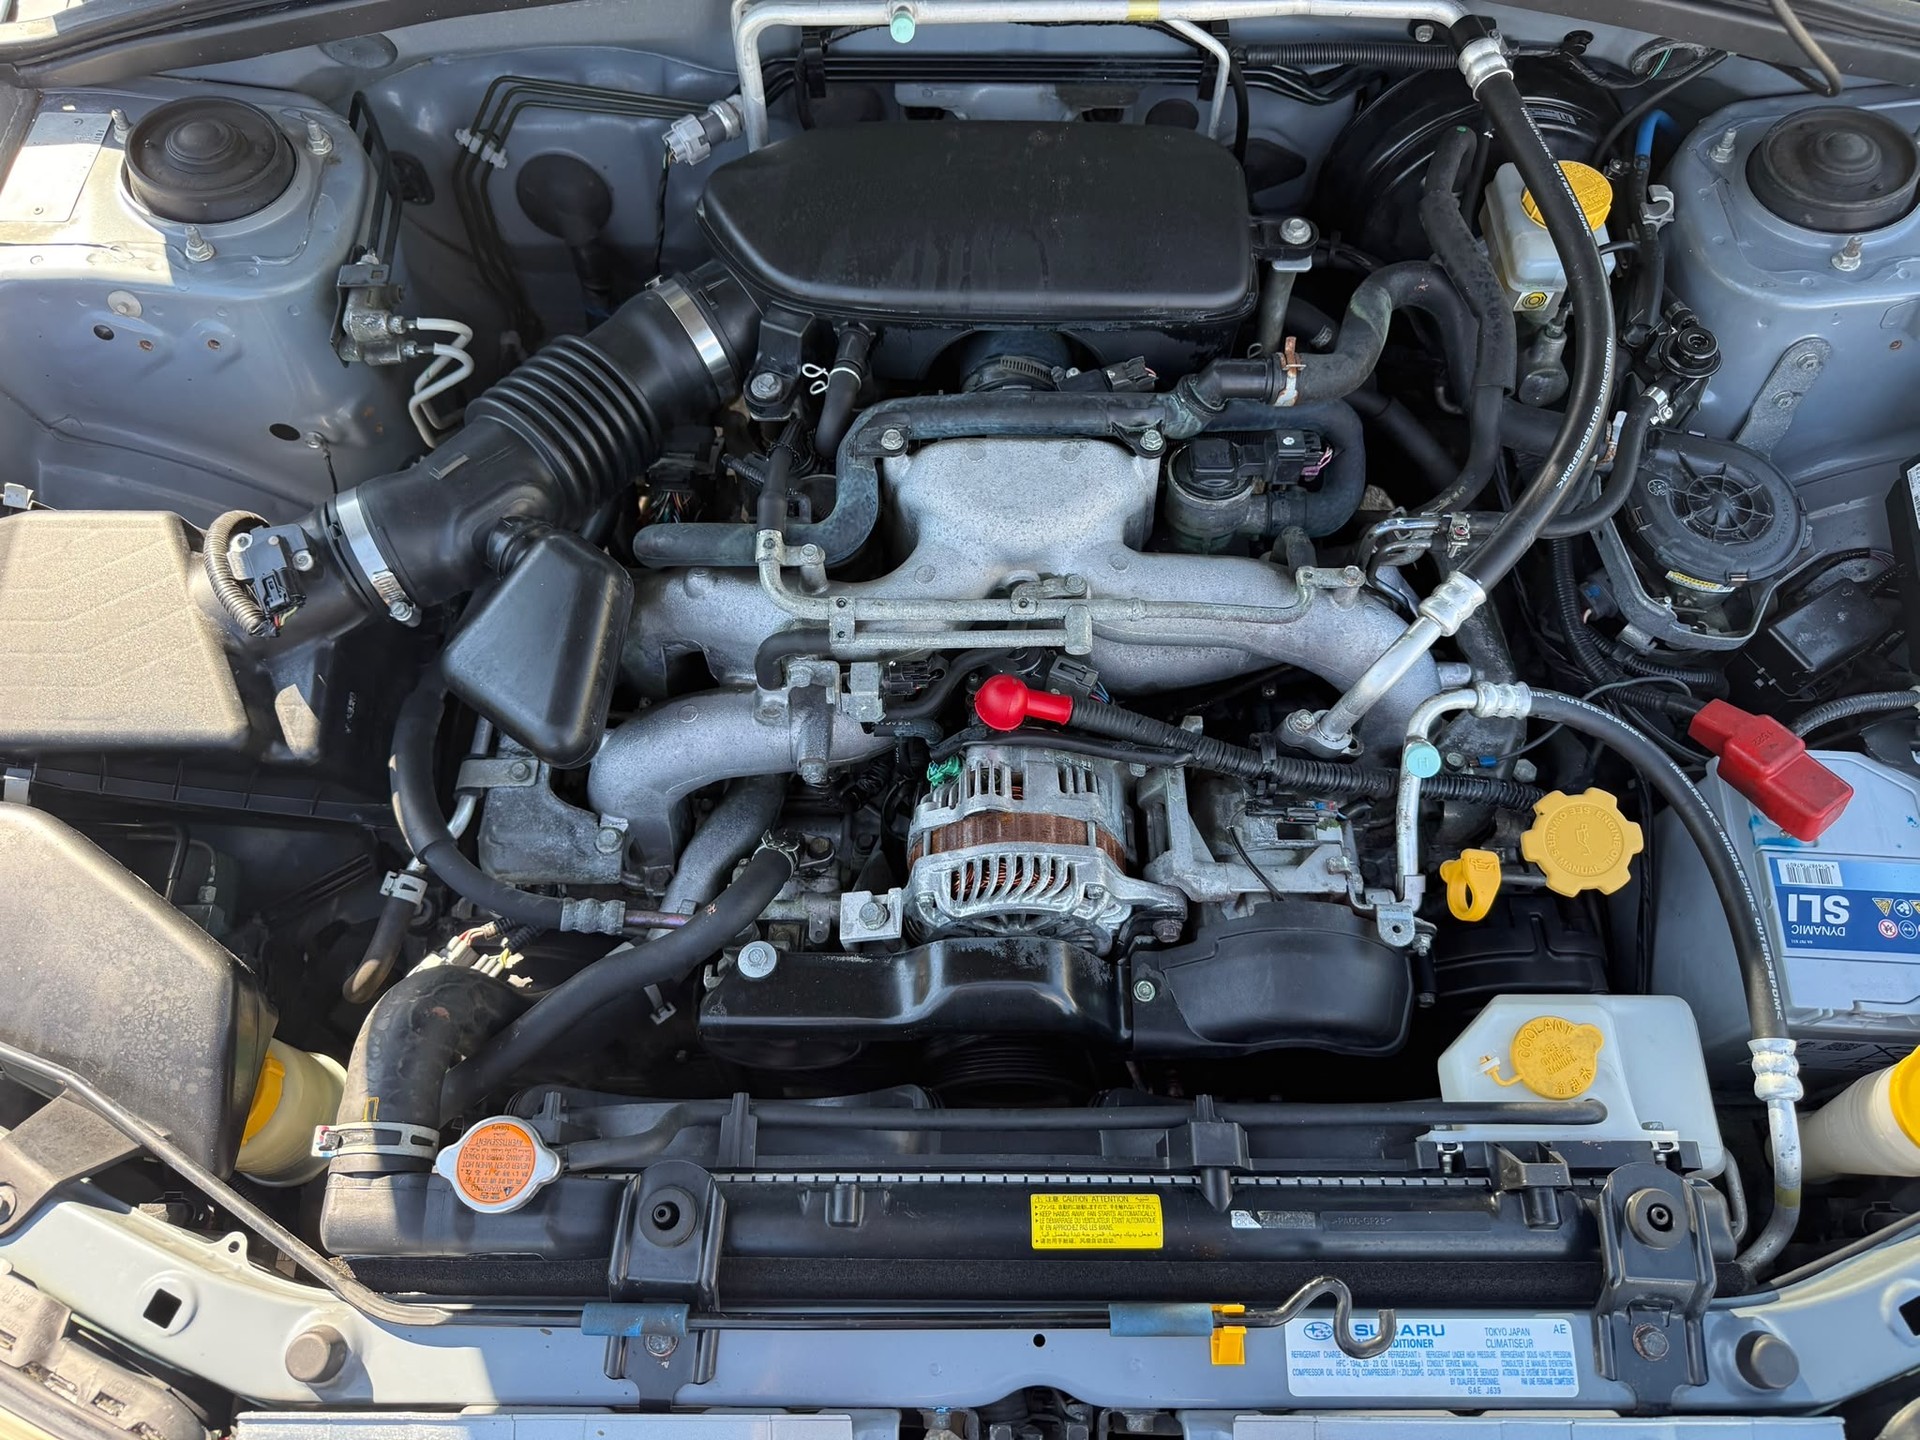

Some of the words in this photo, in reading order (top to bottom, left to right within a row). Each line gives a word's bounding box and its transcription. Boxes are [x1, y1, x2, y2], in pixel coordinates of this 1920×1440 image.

[1787, 893, 1850, 925] SLI
[1790, 924, 1846, 936] DYNAMIC
[1518, 1019, 1574, 1058] COOLANT
[1354, 1324, 1445, 1336] SARU
[1484, 1327, 1507, 1336] TOKYO
[1508, 1327, 1531, 1336] JAPAN
[1553, 1324, 1567, 1334] AE
[1485, 1338, 1534, 1348] CLIMATISEUR
[1467, 1386, 1481, 1395] SAE
[1486, 1386, 1502, 1395] J639
